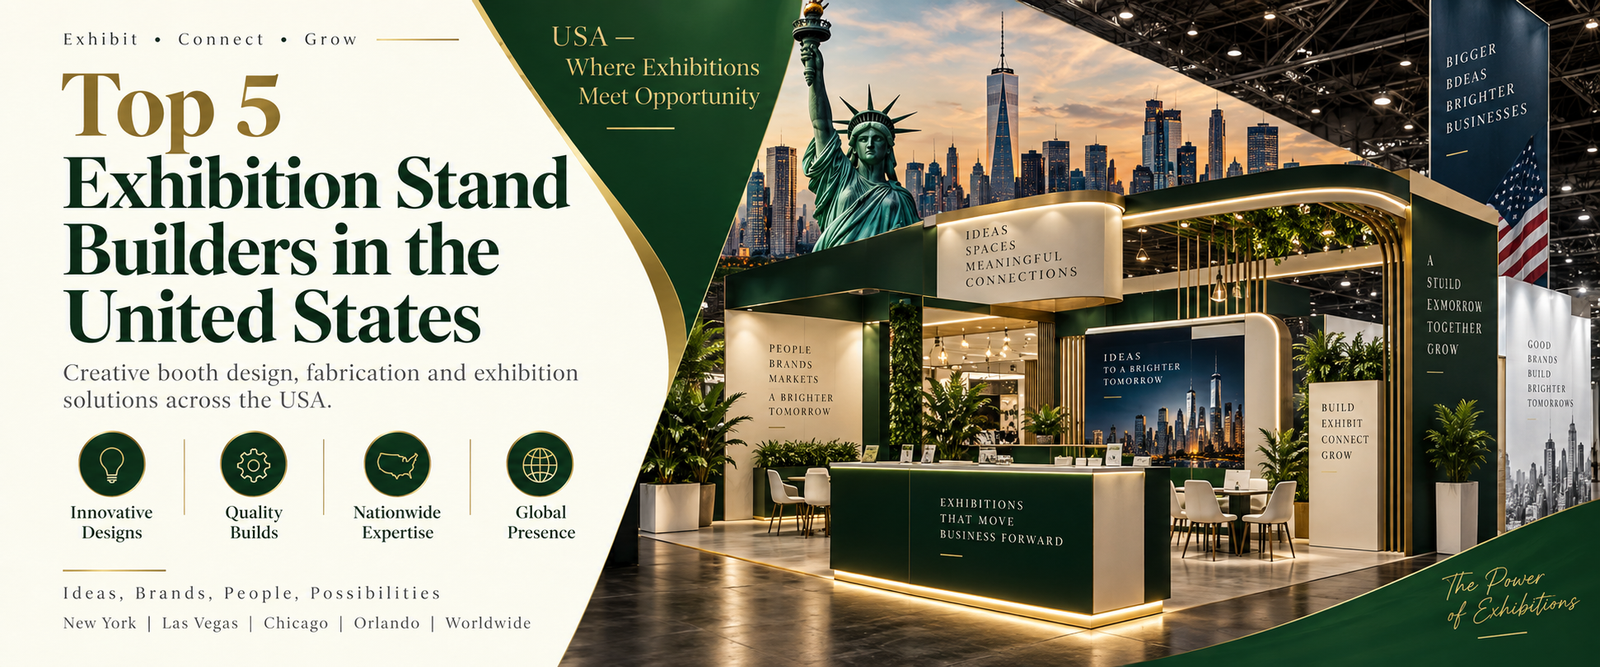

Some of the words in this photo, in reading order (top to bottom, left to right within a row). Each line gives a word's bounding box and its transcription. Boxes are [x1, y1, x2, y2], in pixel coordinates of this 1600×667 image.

[1446, 42, 1497, 68] BIGGER
[1446, 82, 1515, 112] BRIGHTER
[1446, 102, 1528, 134] BUSINESSES
[966, 224, 1009, 241] IDEAS
[966, 240, 1017, 256] SPACES
[966, 251, 1062, 272] MEANINGFUL
[1427, 255, 1433, 266] A
[966, 266, 1078, 288] CONNECTIONS
[1427, 320, 1482, 335] TOGETHER
[1527, 339, 1551, 349] GOOD
[769, 344, 812, 355] PEOPLE
[1427, 343, 1459, 356] GROW
[1104, 352, 1141, 362] IDEAS
[1527, 354, 1558, 364] BRANDS
[769, 359, 813, 369] BRANDS
[1119, 365, 1126, 373] A
[1129, 362, 1181, 373] BRIGHTER
[1527, 369, 1551, 378] BUILD
[769, 374, 819, 384] MARKETS
[1104, 376, 1163, 386] TOMORROW
[1527, 383, 1566, 393] BRIGHTER
[769, 393, 776, 402] A
[781, 393, 834, 402] BRIGHTER
[1322, 403, 1354, 412] BUILD
[1527, 398, 1574, 408] TOMORROWS
[769, 407, 831, 416] TOMORROW
[1322, 419, 1363, 428] EXHIBIT
[1322, 435, 1369, 444] CONNECT
[1322, 451, 1353, 460] GROW
[940, 498, 1024, 511] EXHIBITIONS
[940, 514, 973, 525] THAT
[979, 516, 1014, 526] MOVE
[940, 529, 996, 542] BUSINESS
[1001, 533, 1064, 546] FORWARD
